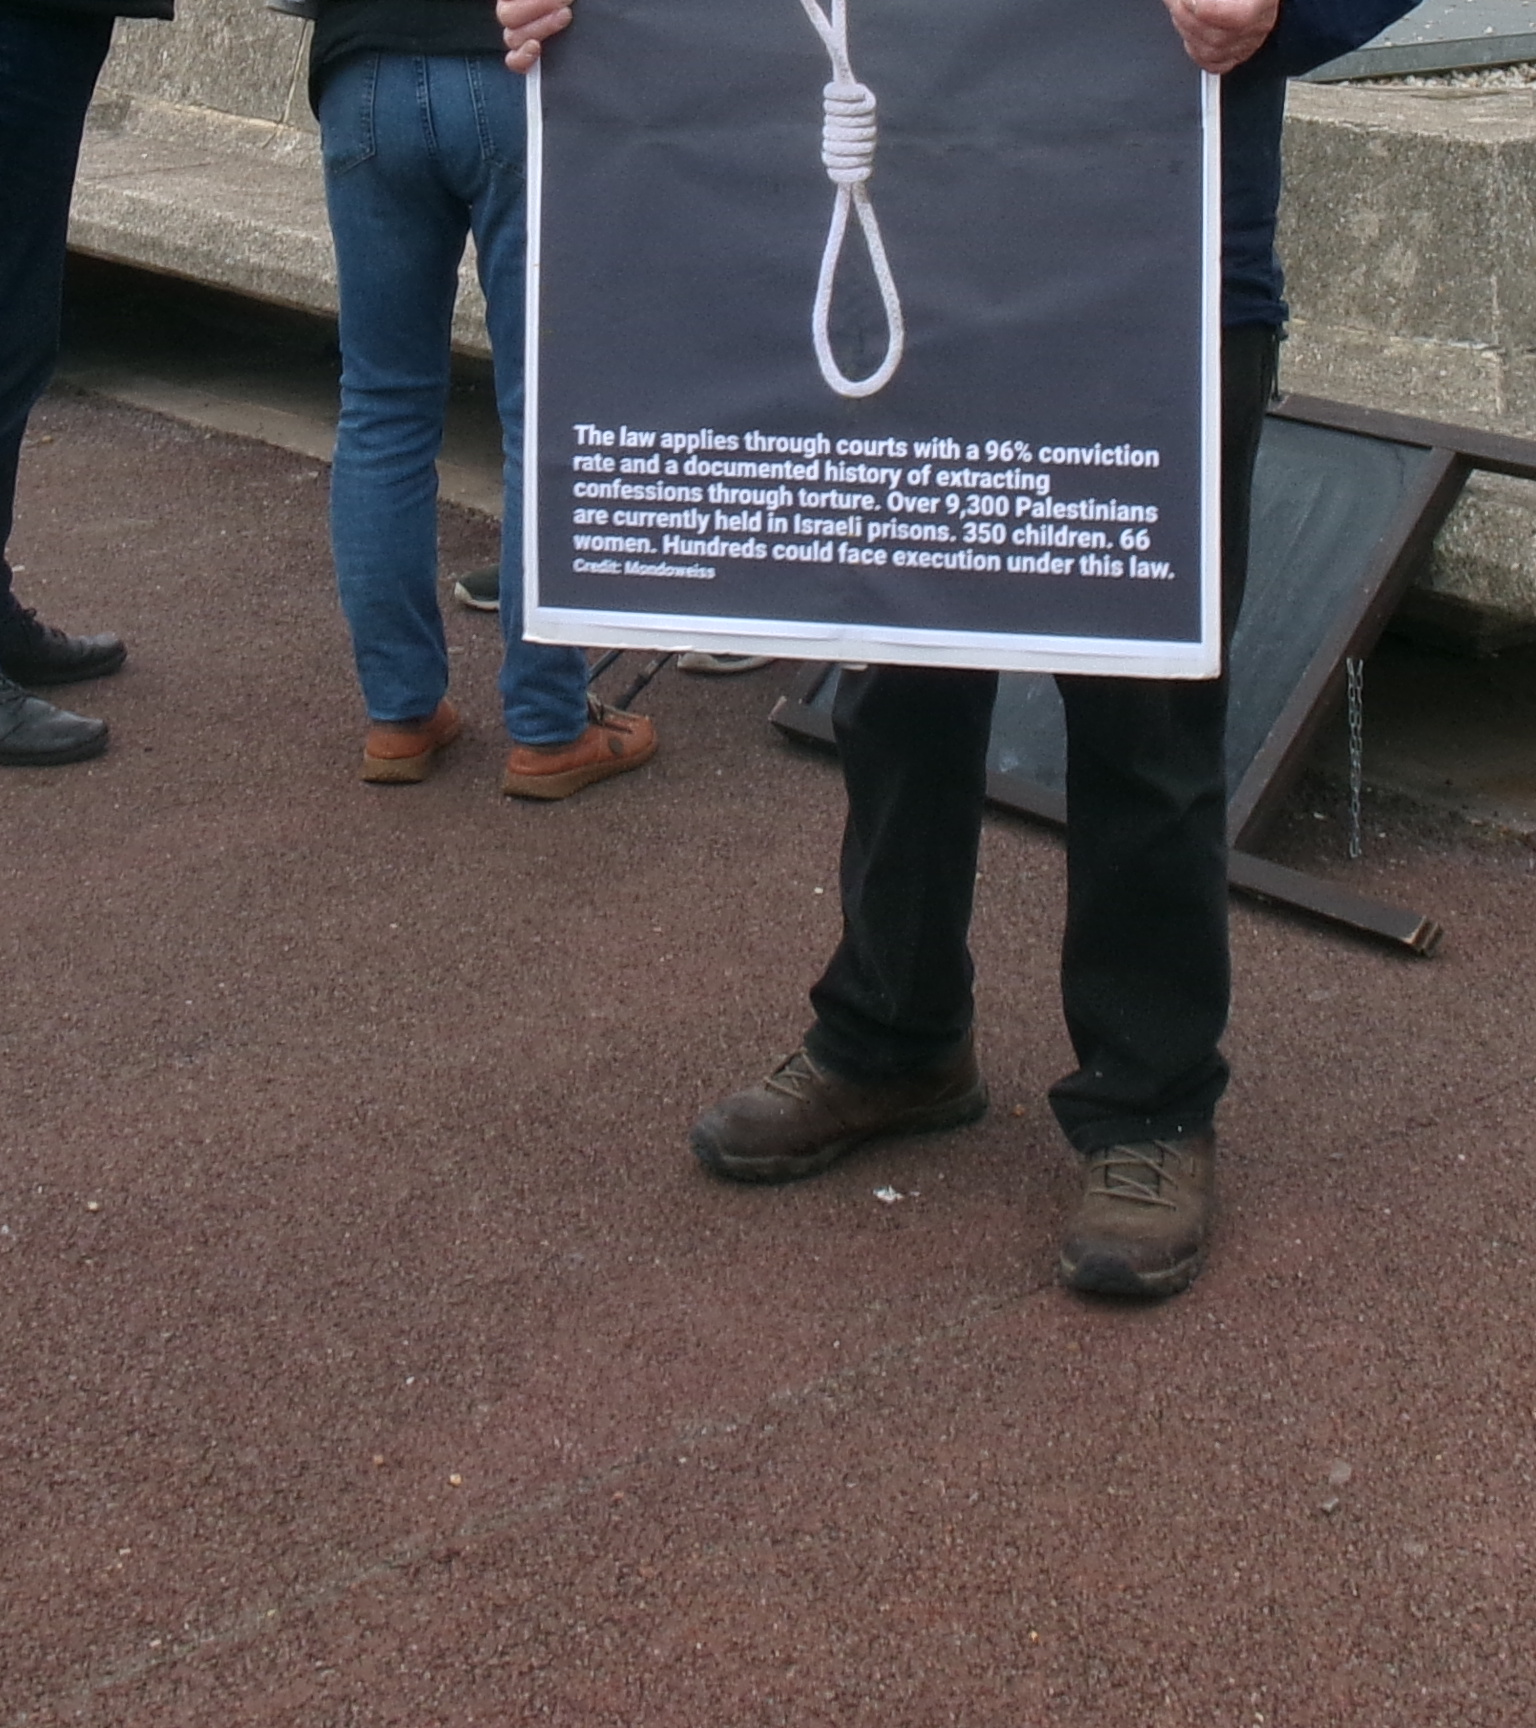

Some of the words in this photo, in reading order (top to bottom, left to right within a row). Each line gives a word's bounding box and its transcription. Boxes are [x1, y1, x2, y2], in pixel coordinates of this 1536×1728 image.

[574, 424, 615, 446] The
[620, 426, 656, 447] law
[661, 429, 738, 454] applies
[744, 431, 830, 458] through
[836, 438, 907, 457] courts
[914, 437, 960, 459] with
[966, 444, 979, 460] a
[985, 440, 1032, 462] 96%
[1039, 443, 1159, 466] conviction
[574, 454, 615, 472] rate
[620, 454, 659, 474] and
[665, 460, 678, 474] a
[684, 455, 819, 480] documented
[825, 460, 902, 489] history
[907, 464, 931, 485] of
[936, 468, 1050, 495] extracting
[574, 478, 702, 502] confessions
[708, 483, 793, 510] through
[799, 489, 880, 510] torture.
[887, 491, 940, 513] Over
[946, 494, 1009, 519] 9,300
[1016, 497, 1157, 522] Palestinians
[574, 509, 608, 524] are
[613, 509, 710, 534] currently
[715, 509, 761, 531] held
[768, 512, 788, 533] in
[794, 514, 861, 536] Israeli
[868, 518, 956, 542] prisons.
[963, 522, 1006, 544] 350
[1012, 524, 1113, 548] children.
[1120, 529, 1150, 550] 66
[574, 535, 657, 553] women.
[663, 535, 767, 558] Hundreds
[773, 541, 833, 562] could
[838, 542, 887, 565] face
[893, 549, 1000, 571] execution
[1007, 552, 1074, 574] under
[1080, 554, 1123, 576] this
[1130, 555, 1174, 578] law.
